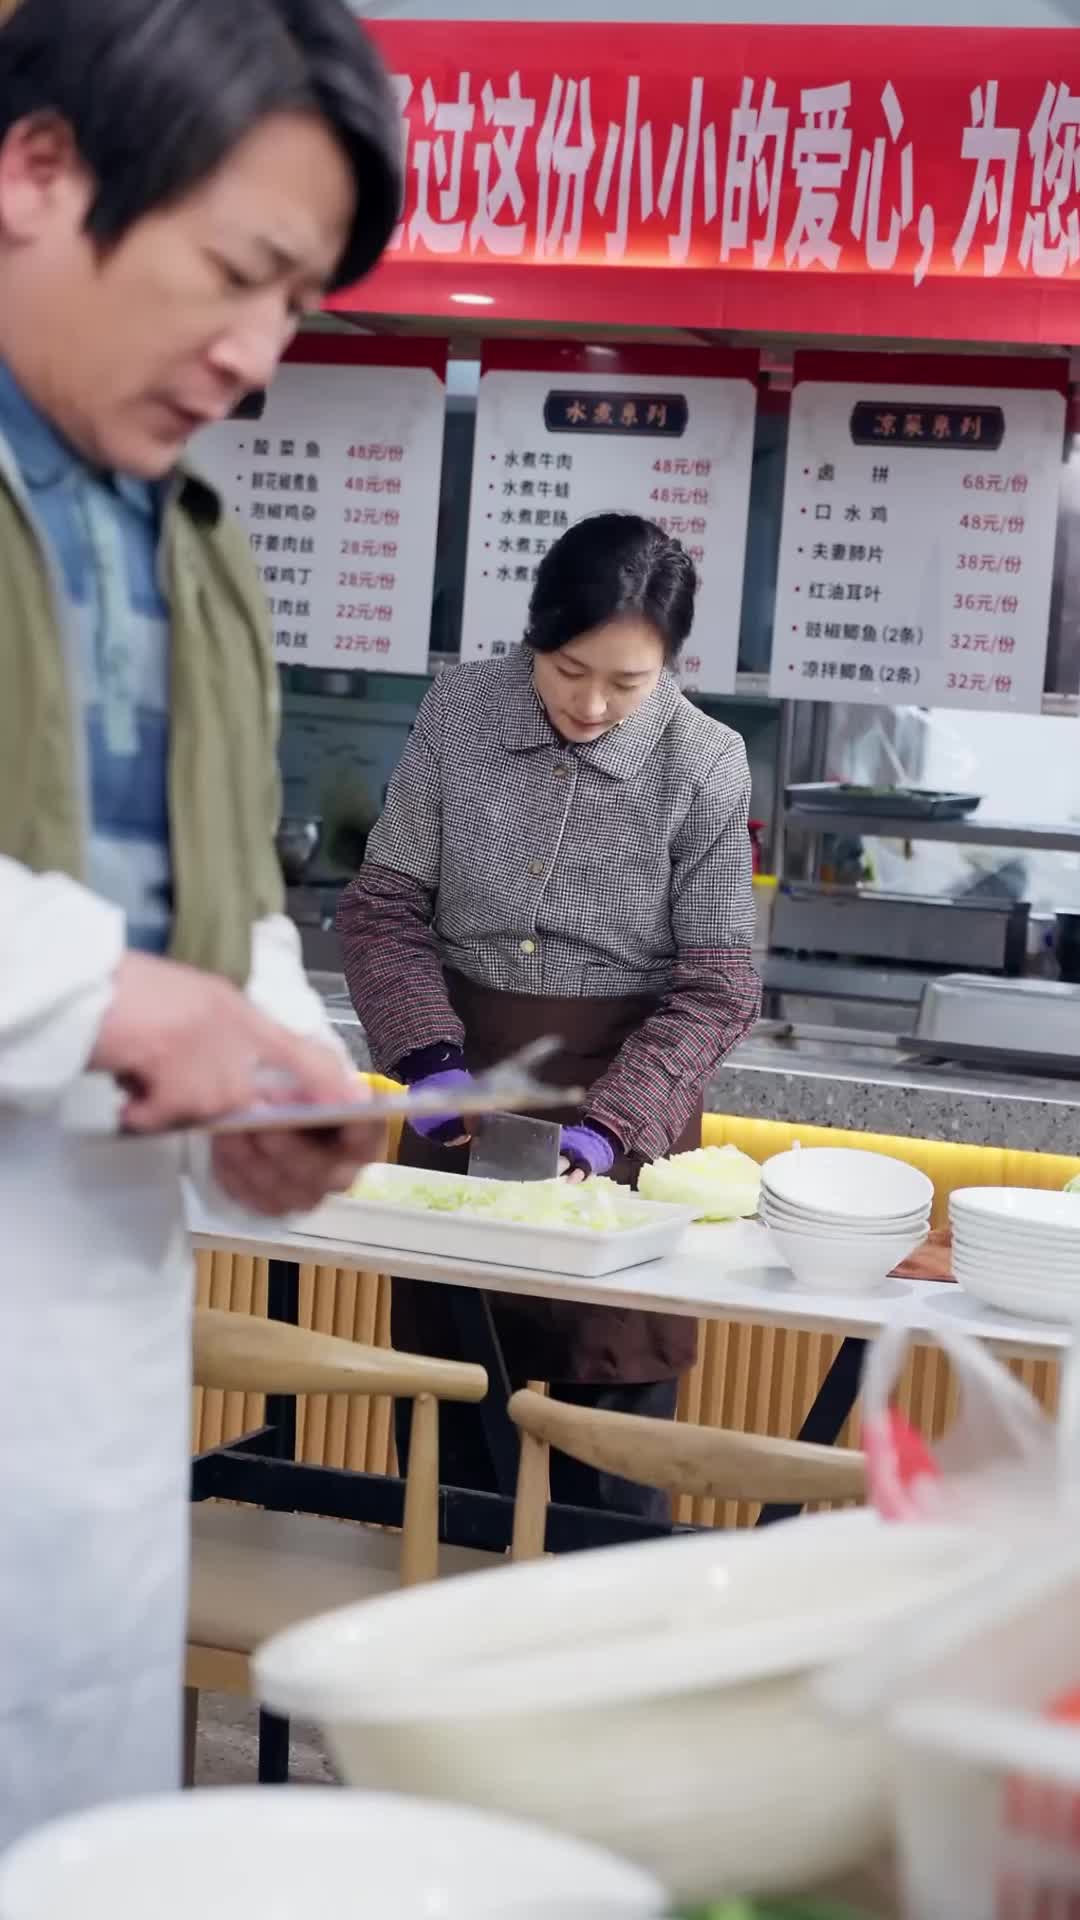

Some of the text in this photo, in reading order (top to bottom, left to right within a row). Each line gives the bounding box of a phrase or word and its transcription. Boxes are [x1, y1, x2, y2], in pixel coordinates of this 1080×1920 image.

[565, 400, 668, 427] 水煮系列
[253, 438, 403, 462] 酸菜鱼 48元/份
[504, 449, 711, 477] 水煮牛肉 48元/份
[252, 470, 402, 494] 鲜花椒煮鱼 48元/份
[502, 478, 709, 506] 水煮牛蛙 48元/份
[962, 472, 1029, 493] 68元/份
[250, 501, 400, 526] 泡椒鸡杂 32元/份
[500, 507, 568, 530] 水煮肥肠
[815, 503, 1025, 534] 口水鸡 48元/份
[340, 539, 398, 558] 28元/份
[812, 542, 1022, 574] 夫妻肺片 38元/份
[256, 564, 395, 590] 保鸡丁 28元/份
[808, 581, 1019, 614] 红油耳叶 36元/份
[335, 603, 393, 622] 22元/份
[273, 629, 391, 654] 肉丝 22元/份
[949, 633, 1015, 654] 32元/份
[801, 660, 1012, 693] 凉拌鲫鱼(2条) 32元/份
